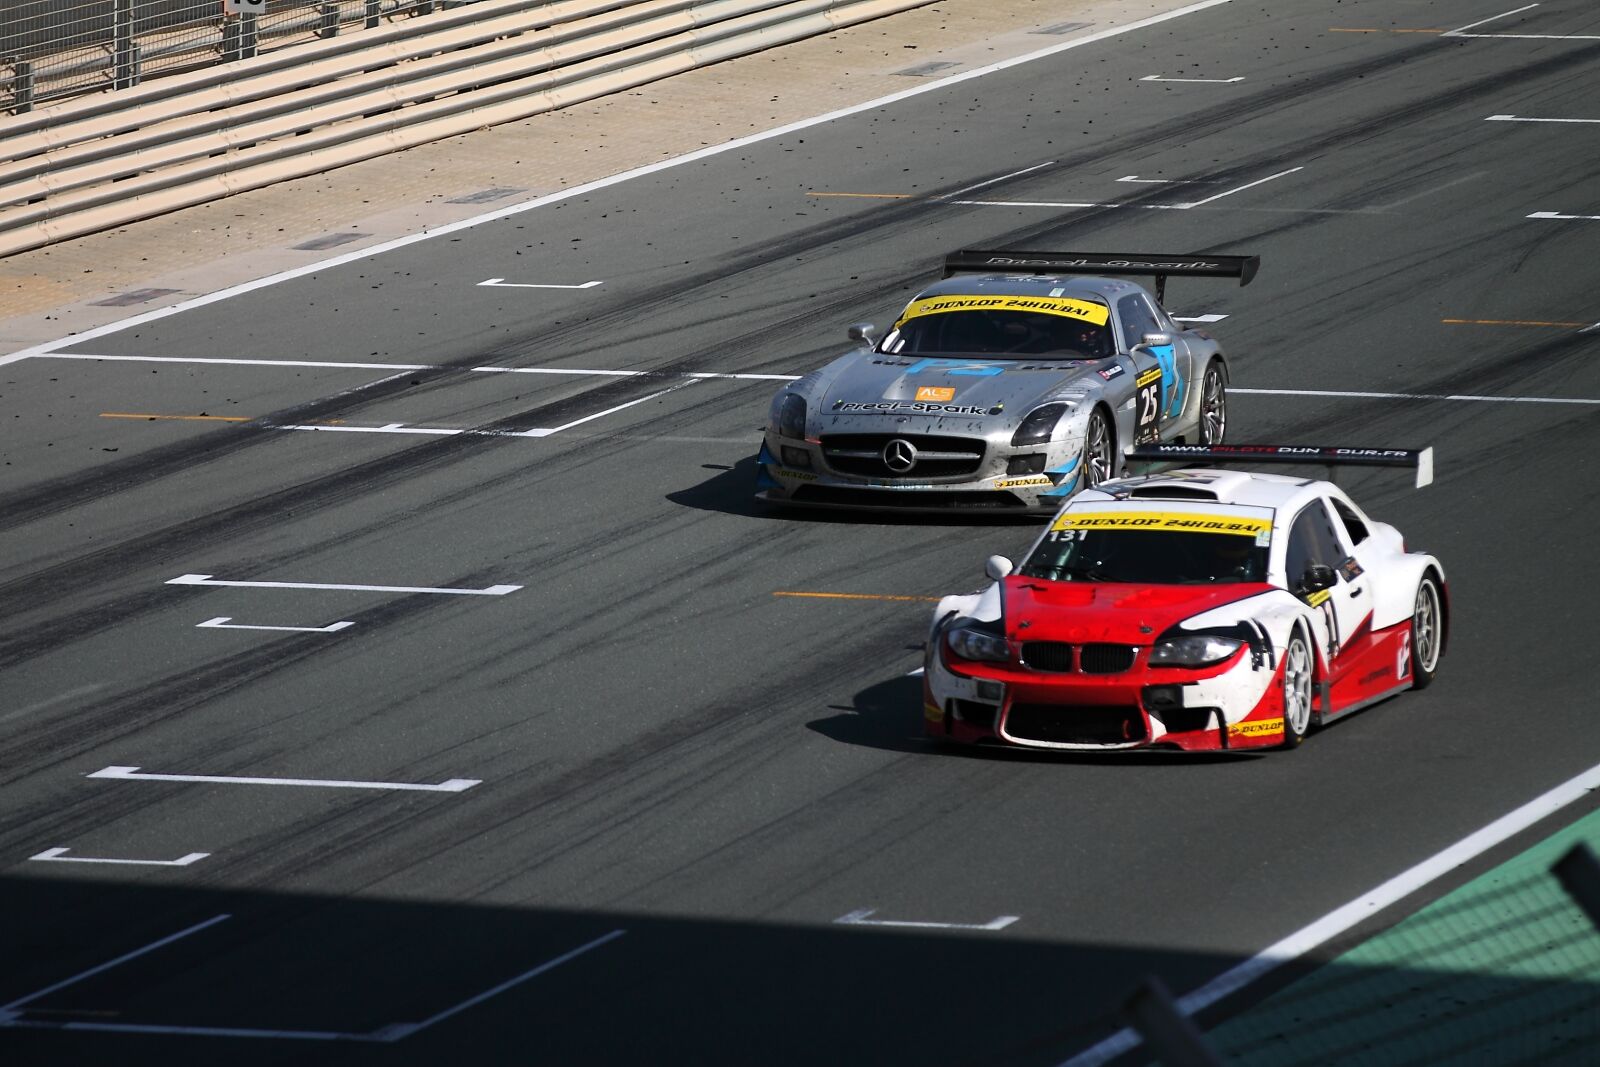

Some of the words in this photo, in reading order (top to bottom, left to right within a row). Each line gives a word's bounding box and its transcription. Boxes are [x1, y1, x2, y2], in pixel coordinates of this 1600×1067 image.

[931, 299, 1002, 311] DUNLOP
[920, 388, 951, 397] ALS
[842, 402, 988, 416] Preci-Spark
[1140, 384, 1158, 425] 25
[1050, 529, 1088, 542] 131
[1242, 721, 1284, 732] DUNLOP
